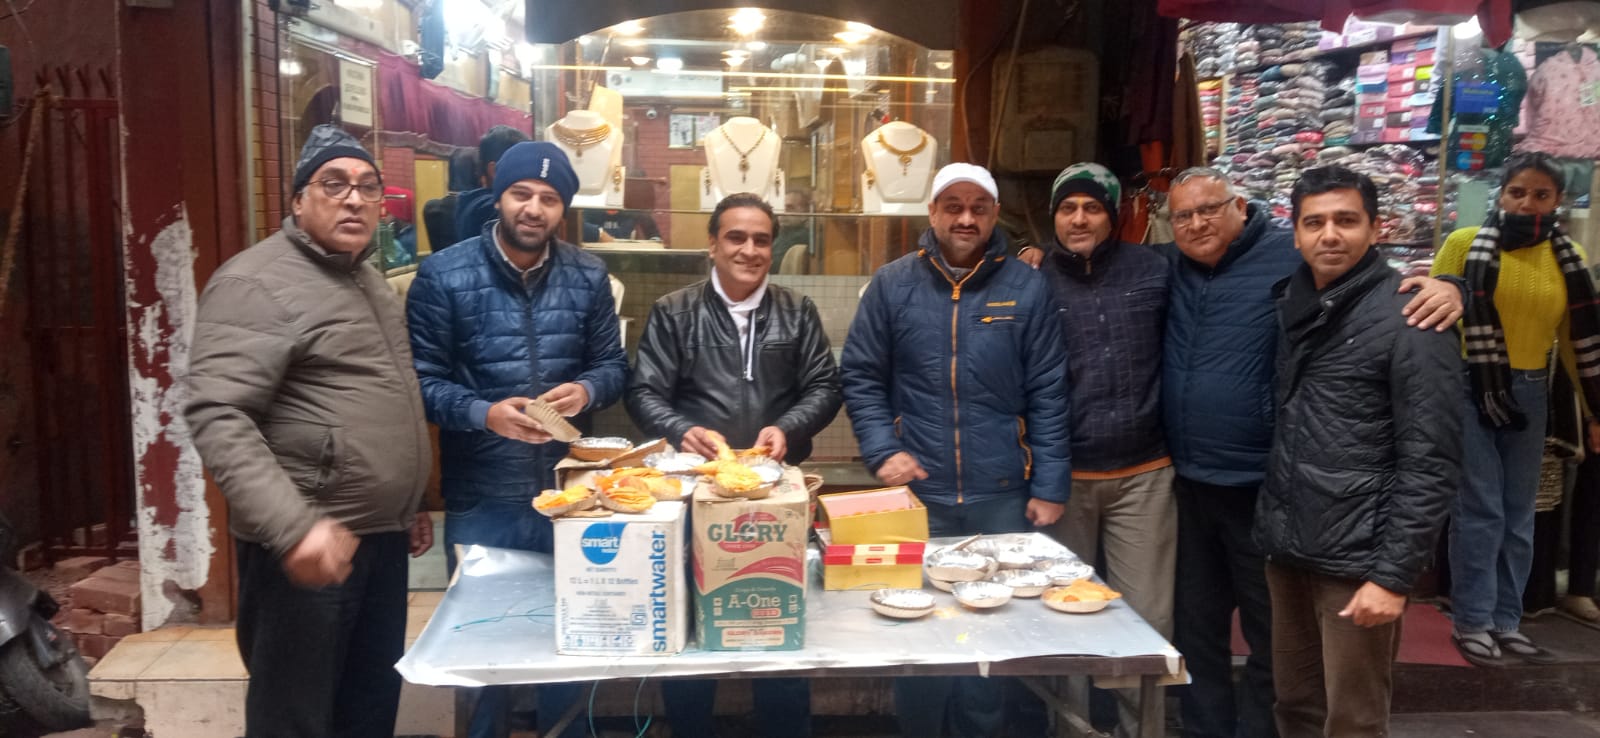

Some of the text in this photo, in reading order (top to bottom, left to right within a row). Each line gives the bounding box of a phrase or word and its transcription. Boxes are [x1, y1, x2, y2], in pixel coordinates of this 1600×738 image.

[708, 523, 787, 542] GLORY
[582, 537, 619, 548] smart
[649, 530, 667, 652] smartwater
[727, 593, 781, 608] A-One
